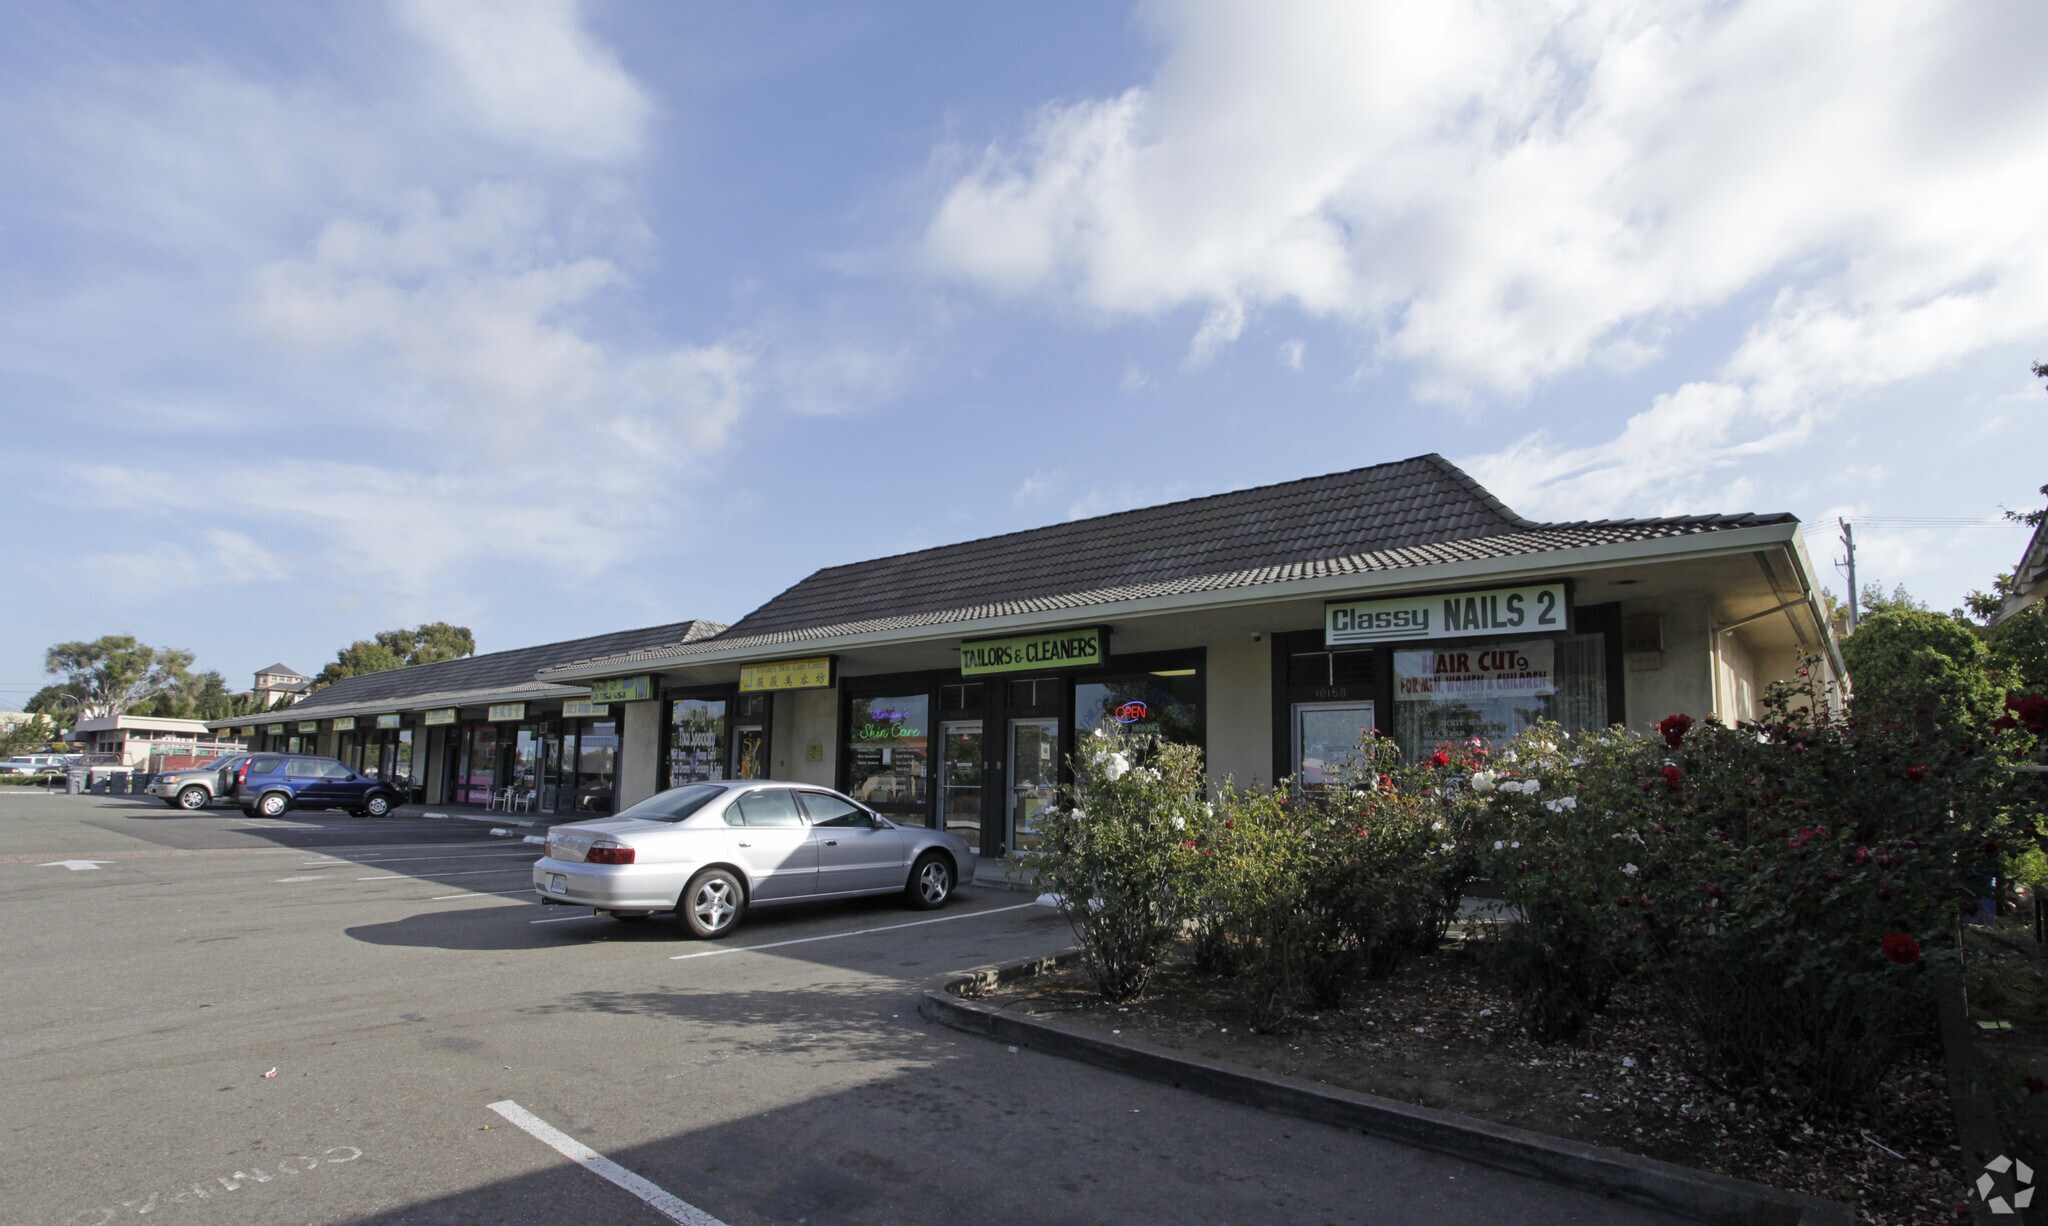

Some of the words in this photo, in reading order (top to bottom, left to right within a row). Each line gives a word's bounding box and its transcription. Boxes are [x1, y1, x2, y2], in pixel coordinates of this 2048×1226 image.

[1332, 608, 1429, 632] Classy
[1444, 593, 1525, 632] NAILS
[1537, 591, 1556, 625] 2
[962, 646, 1012, 668] TAILORS
[1014, 649, 1024, 663] &
[1025, 637, 1097, 662] CLEANERS
[1422, 652, 1470, 675] HAIR
[1478, 650, 1519, 672] CUT
[778, 664, 790, 672] Skin
[792, 662, 806, 671] Care
[1400, 676, 1419, 694] FOR
[1446, 674, 1484, 693] WOMEN
[1496, 671, 1547, 691] CHILDREN
[1115, 705, 1147, 719] OPEN
[860, 723, 889, 739] Skin
[891, 722, 921, 738] Care
[62, 1145, 363, 1226] COMPAC
